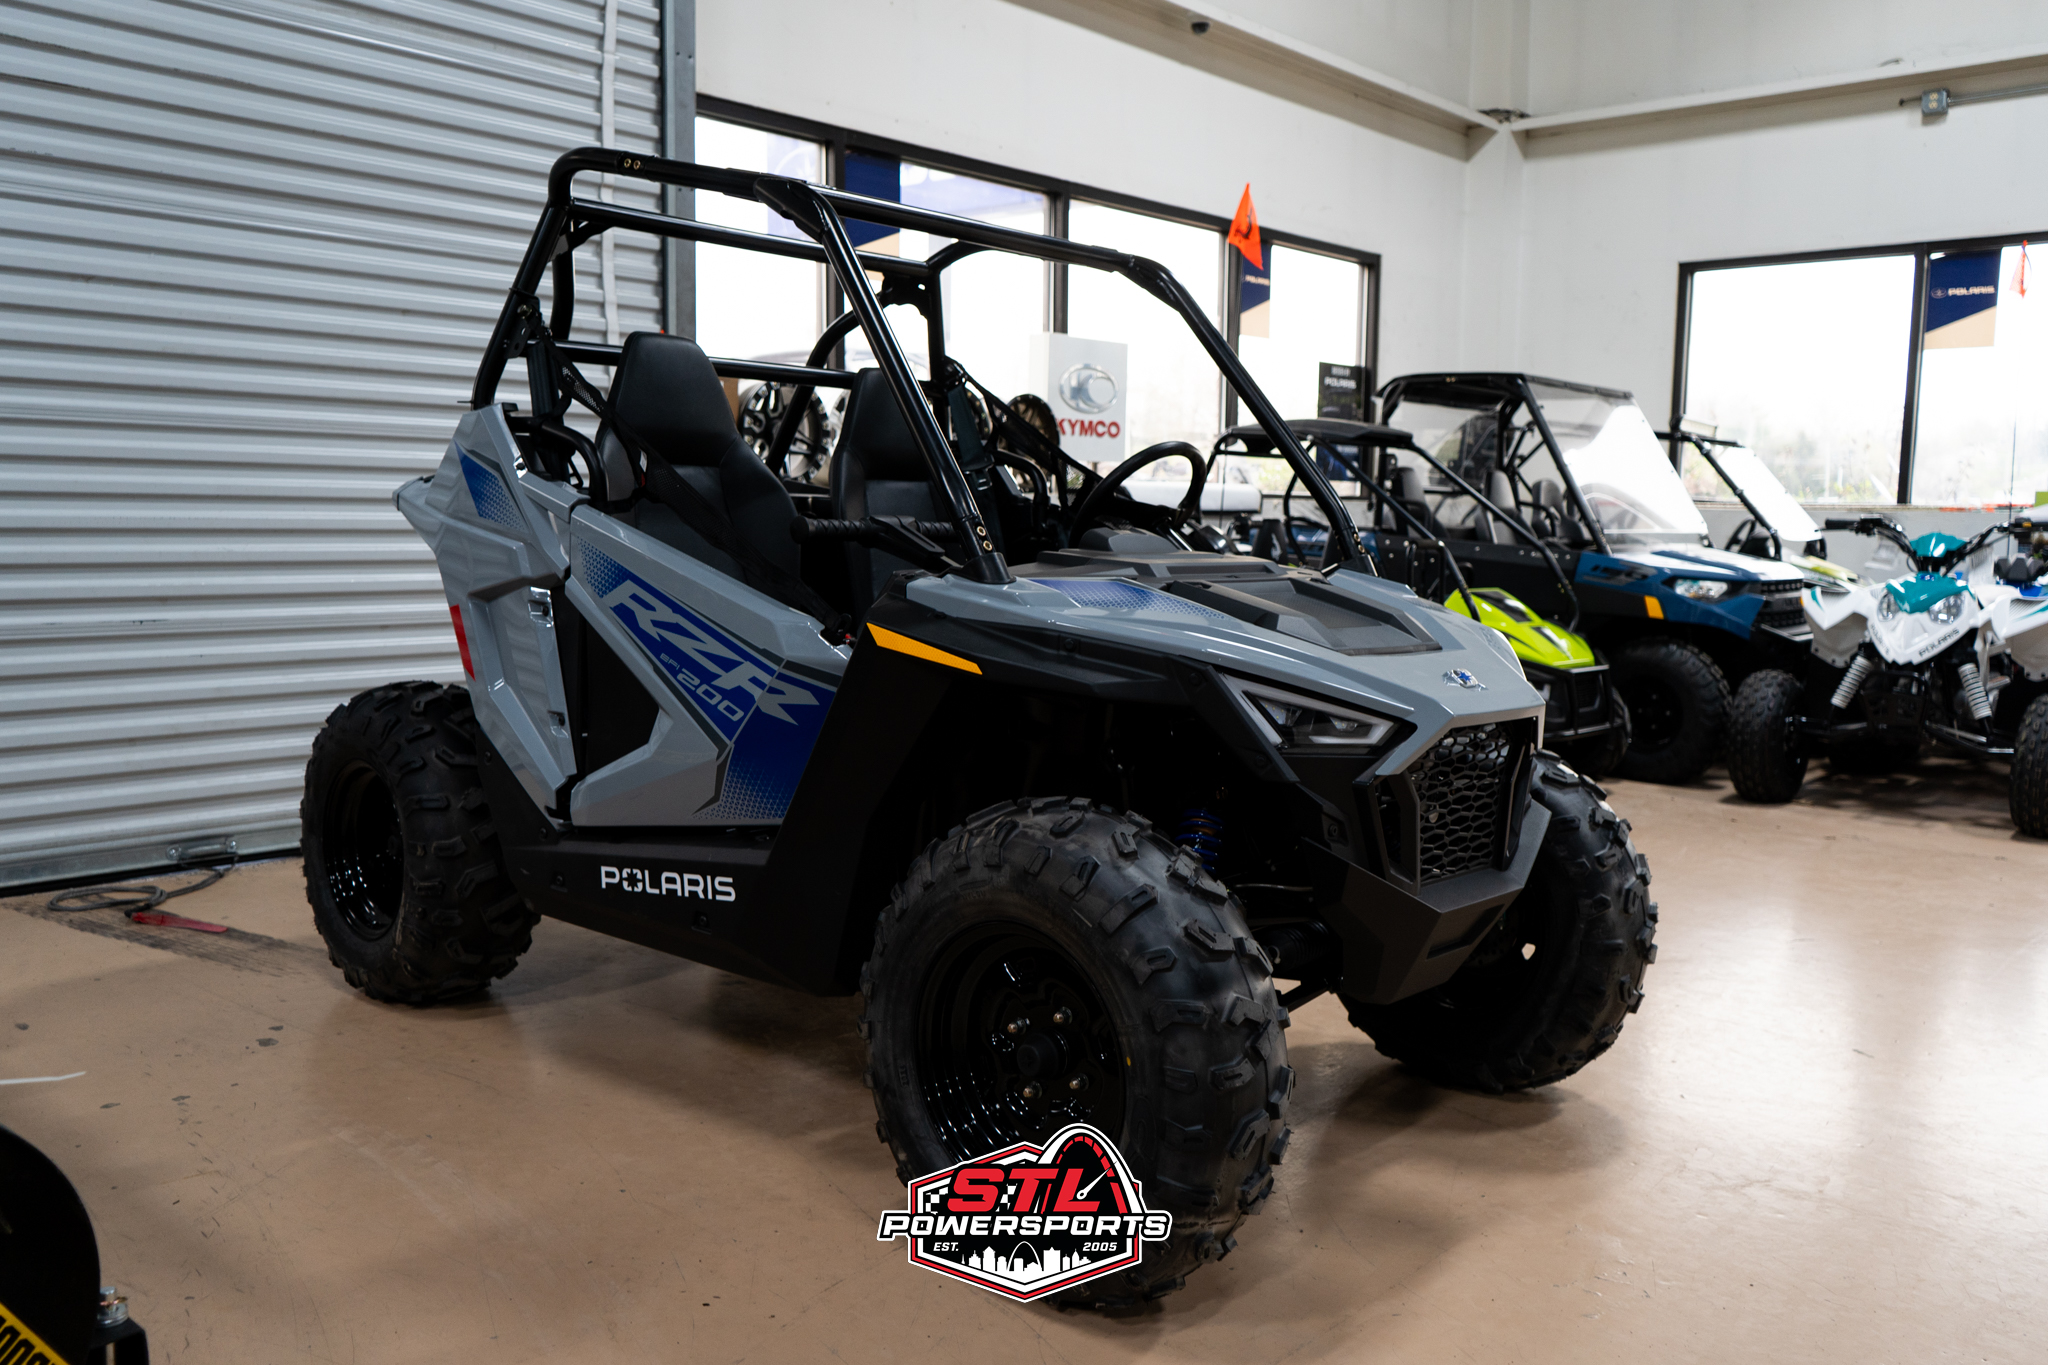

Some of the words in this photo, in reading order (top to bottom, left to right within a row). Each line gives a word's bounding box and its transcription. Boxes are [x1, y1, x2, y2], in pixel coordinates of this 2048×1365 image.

[1947, 285, 1995, 297] POLARIS
[602, 579, 820, 726] RZR
[1919, 628, 1959, 657] POLARIS
[659, 653, 680, 671] EFI
[677, 668, 744, 721] 200
[601, 866, 736, 901] POLARIS
